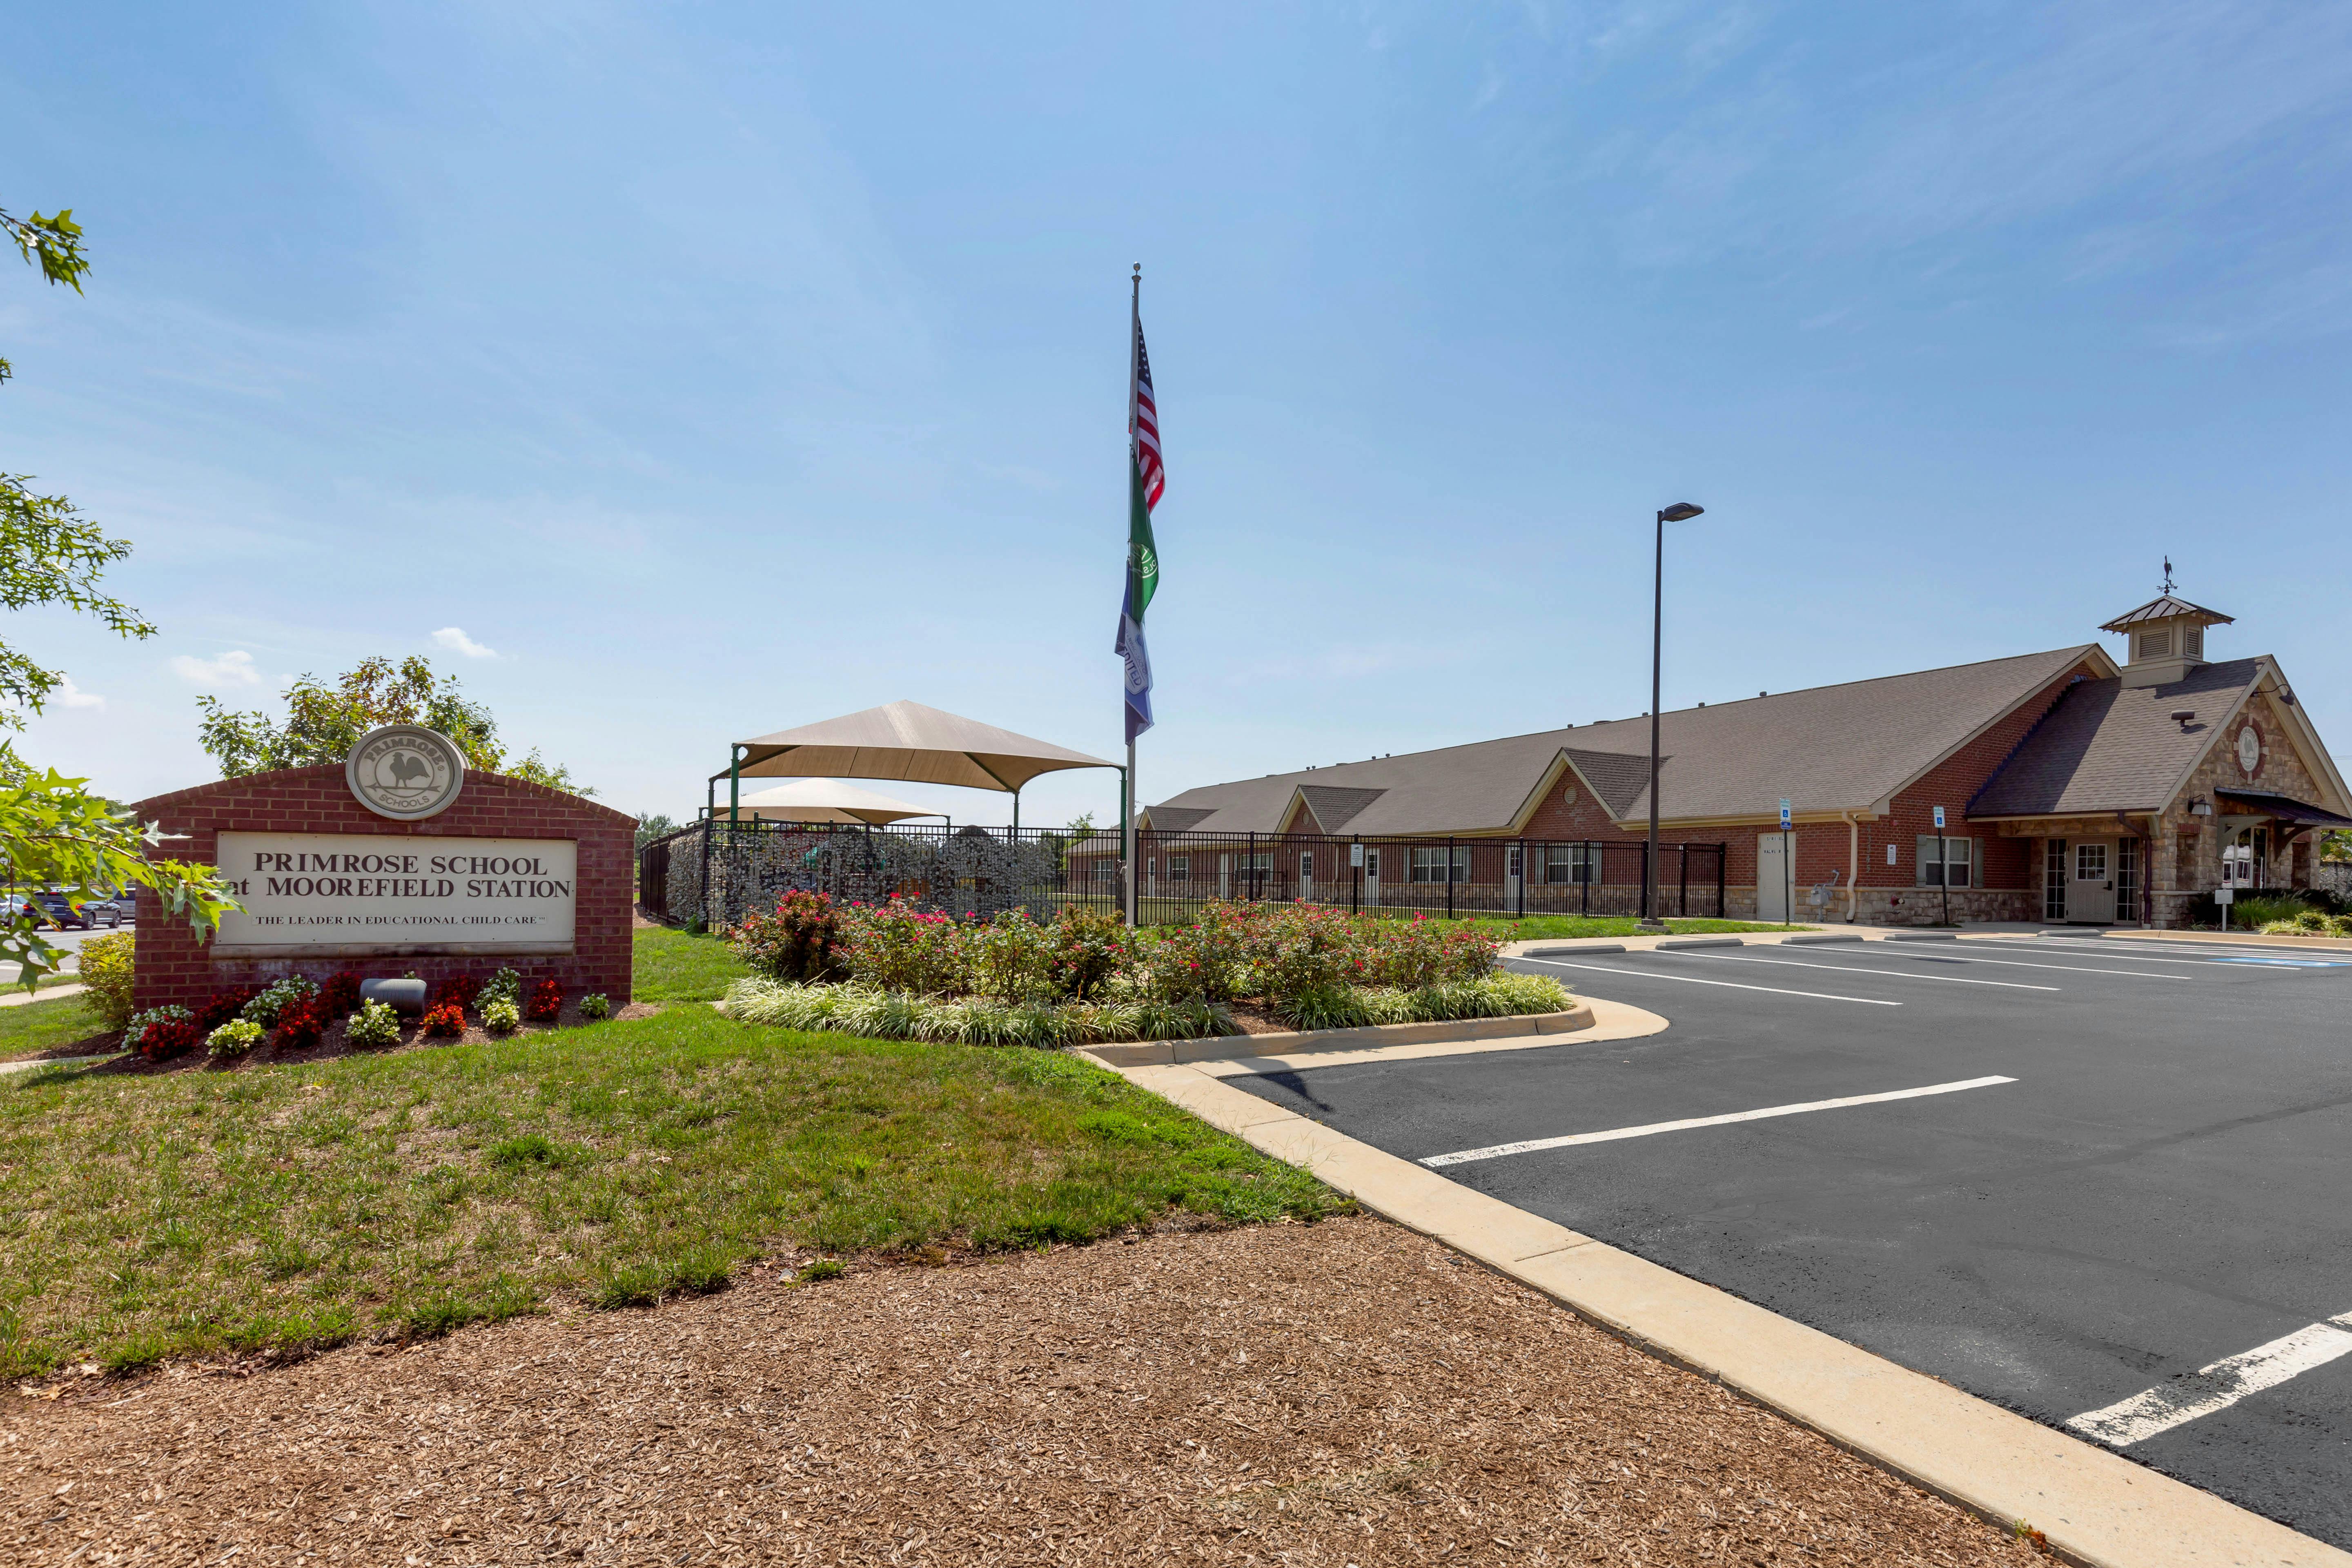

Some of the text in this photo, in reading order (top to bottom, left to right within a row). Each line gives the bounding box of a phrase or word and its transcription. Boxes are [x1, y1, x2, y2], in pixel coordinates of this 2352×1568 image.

[379, 794, 430, 807] SCHOOLS
[253, 853, 548, 875] PRIMROSE SCHOOL
[266, 877, 454, 897] MOOREFIELD
[467, 880, 571, 898] STATION
[256, 916, 284, 924] THE
[289, 916, 343, 924] LEADER
[348, 916, 361, 924] IN
[365, 916, 458, 924] EDUCATIONAL
[462, 916, 501, 924] CHILD
